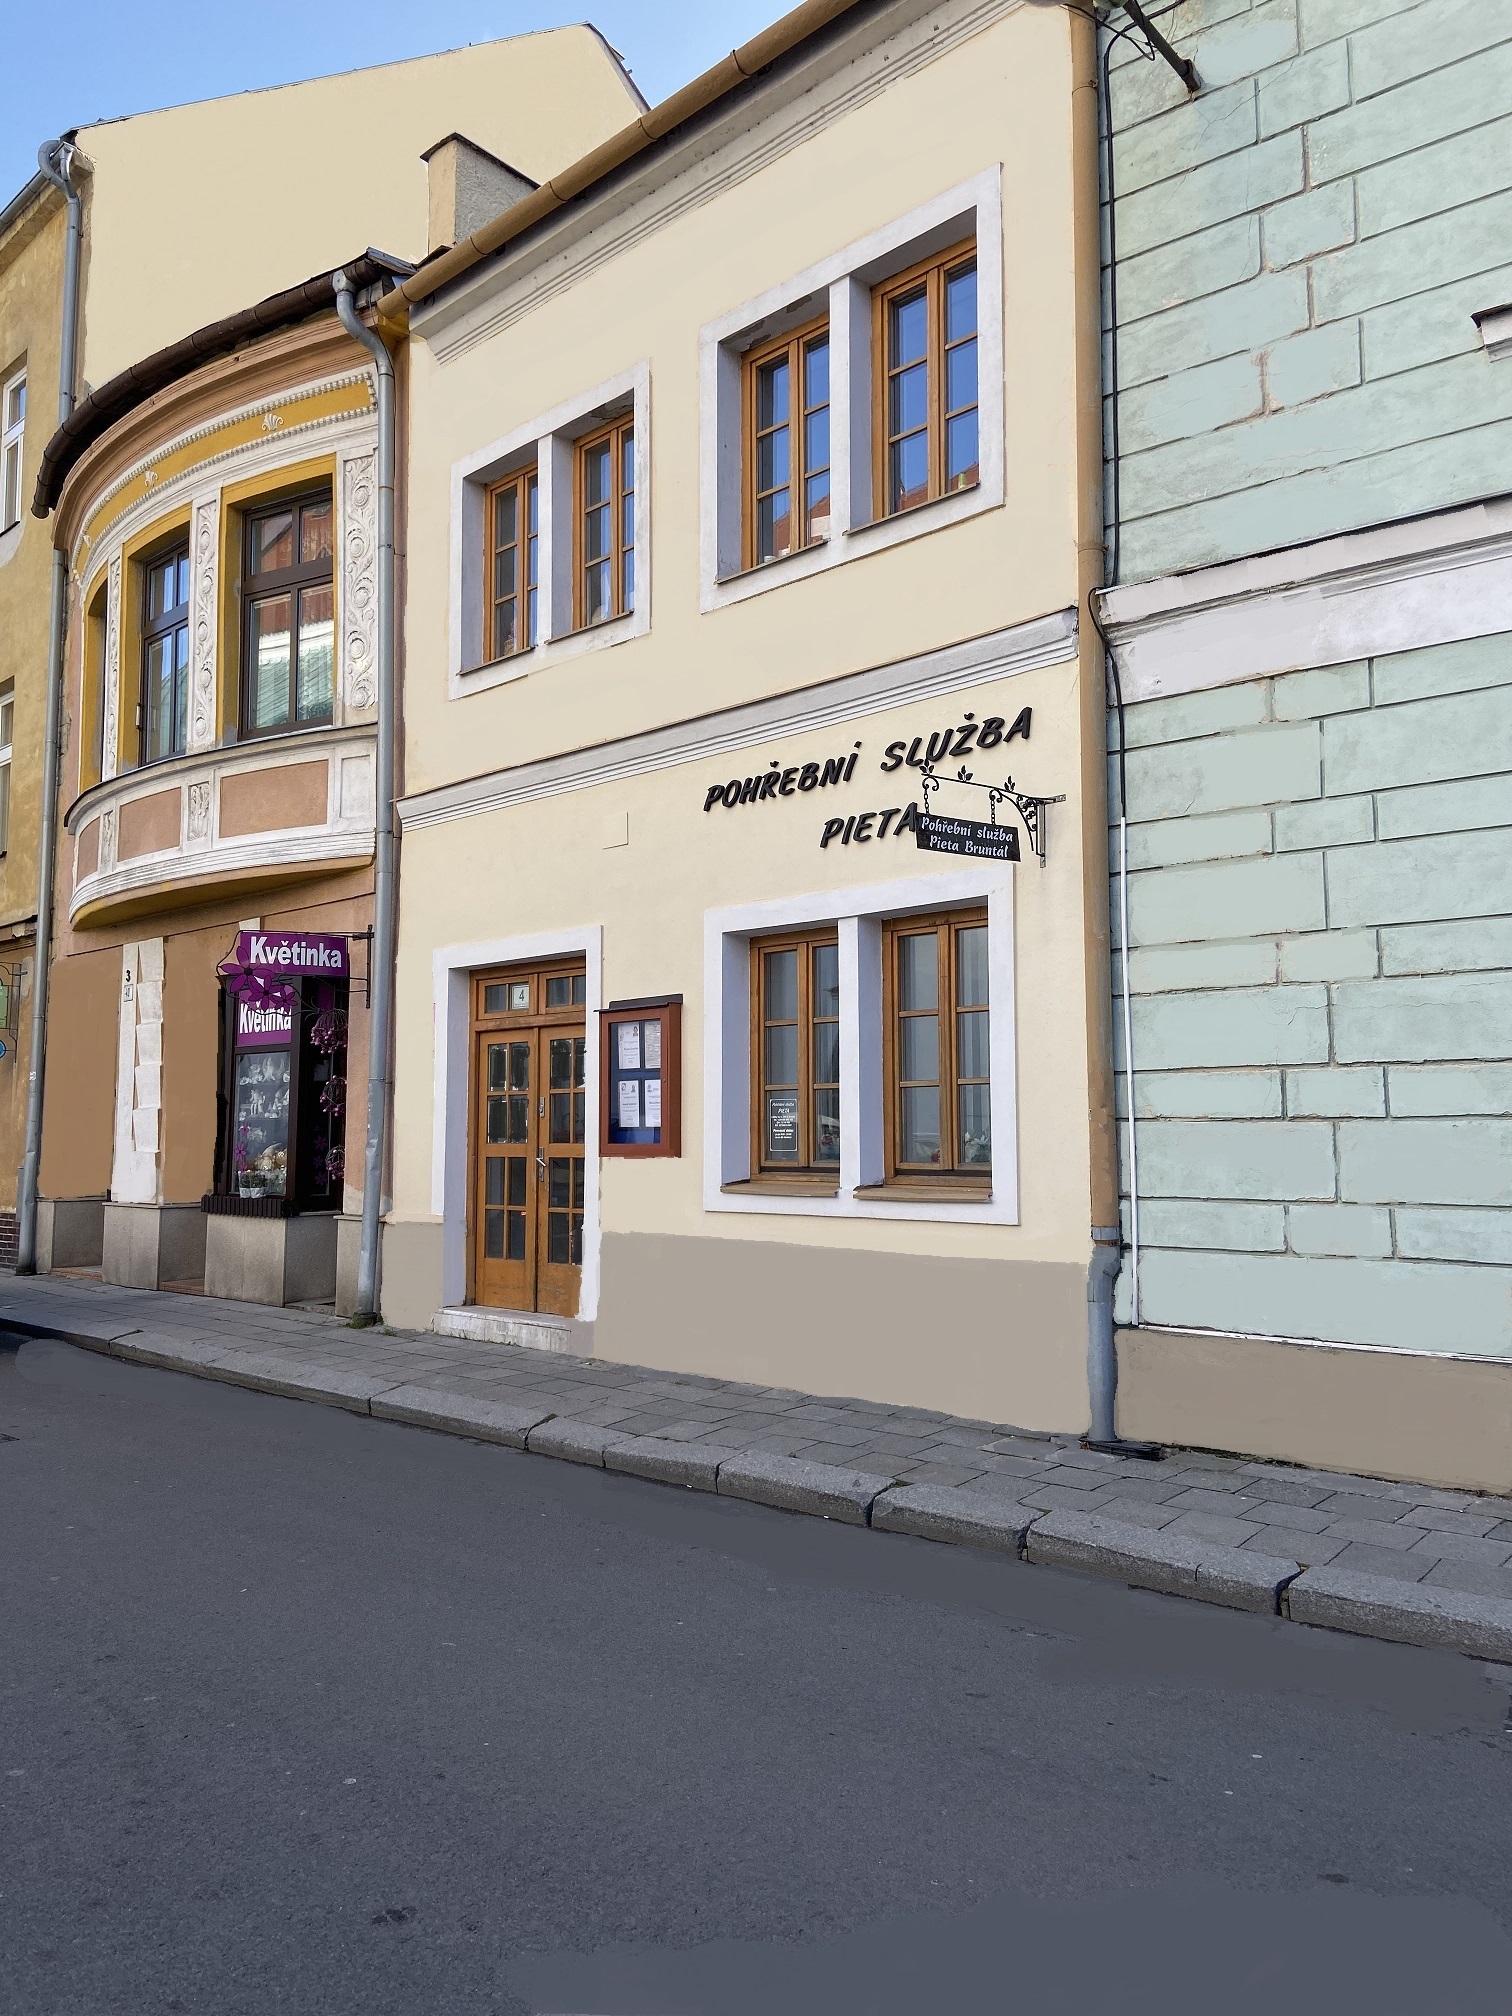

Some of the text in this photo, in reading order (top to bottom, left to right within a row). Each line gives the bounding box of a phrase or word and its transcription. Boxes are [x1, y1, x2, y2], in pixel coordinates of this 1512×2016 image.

[703, 706, 1033, 812] POHŘEBNÍ SLUŽBA
[819, 801, 917, 849] PIETA
[921, 816, 1014, 842] Pohřební služba
[929, 834, 1008, 858] Pieta Bruntál
[250, 936, 342, 968] Květinka
[125, 969, 131, 983] 3
[518, 989, 525, 1002] 4
